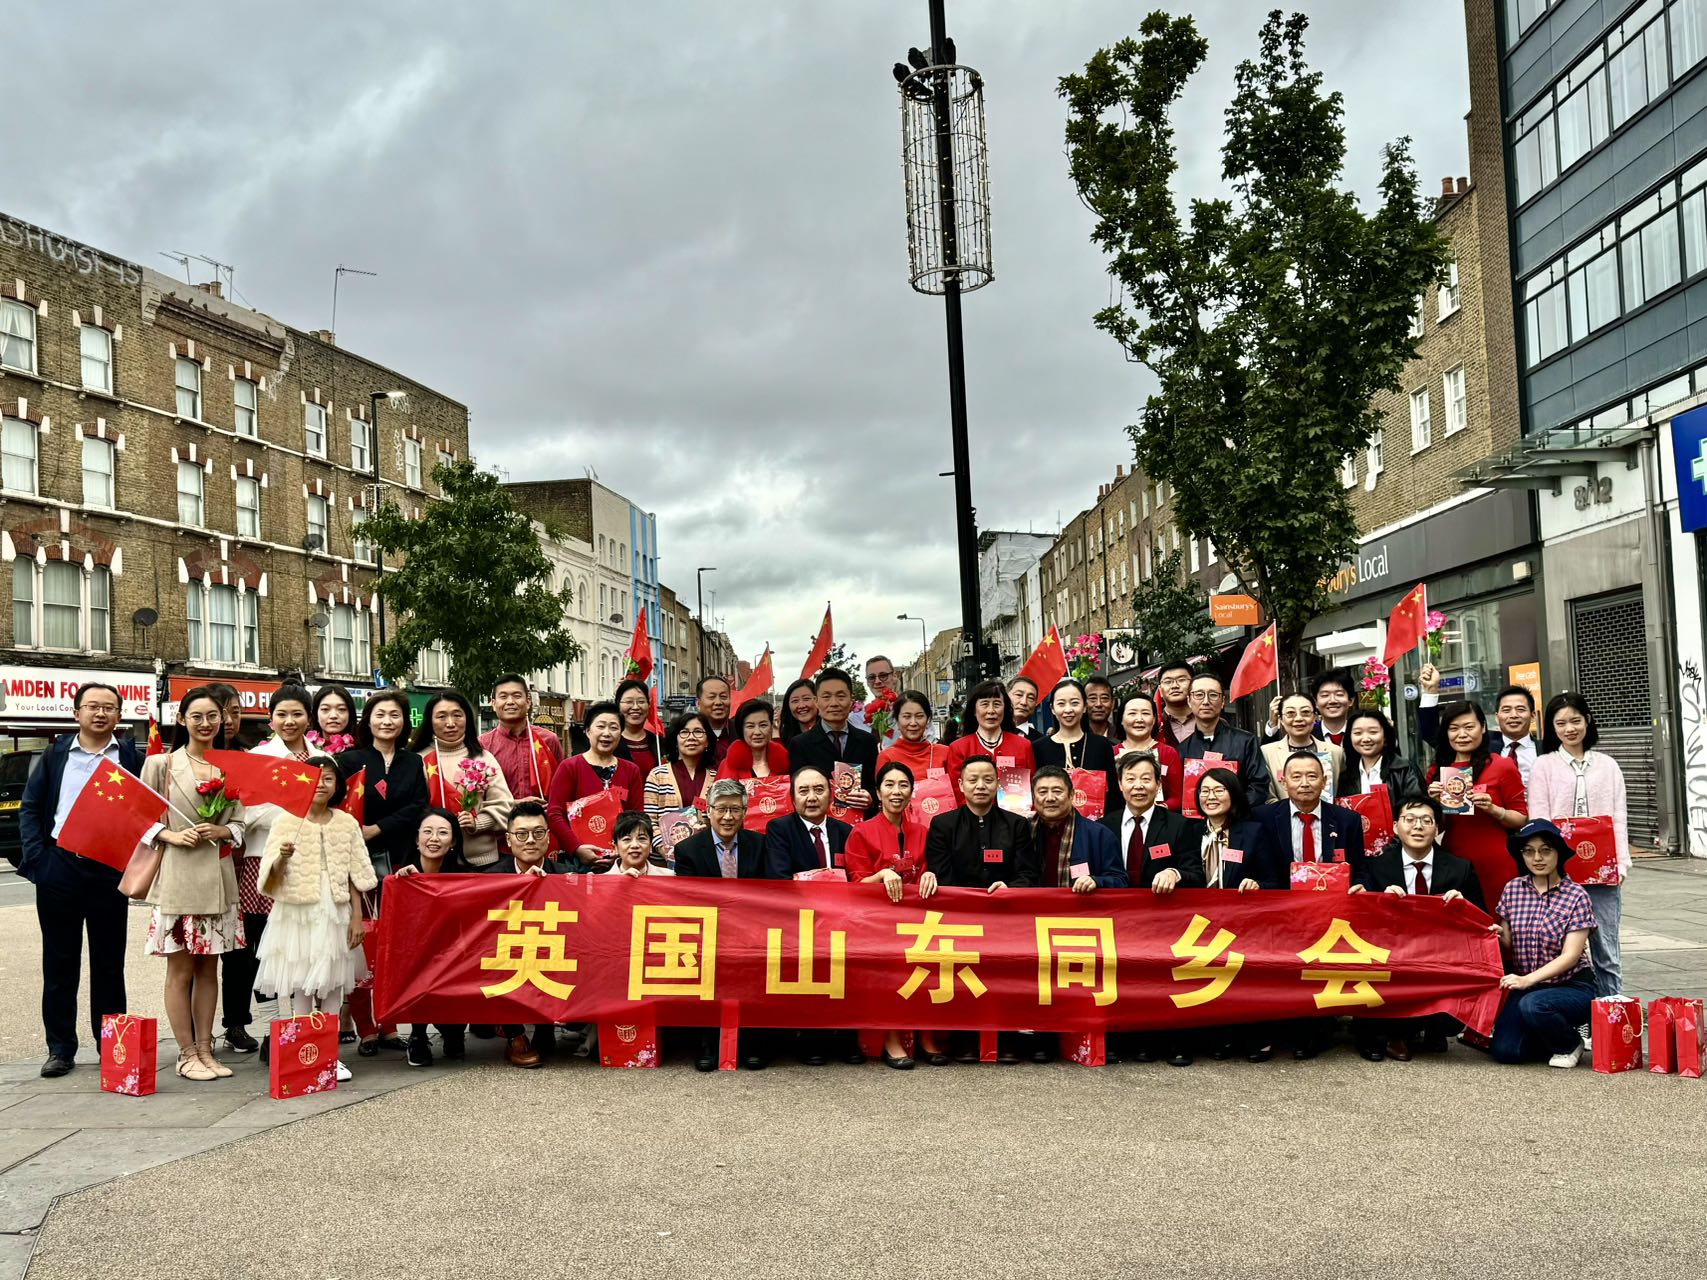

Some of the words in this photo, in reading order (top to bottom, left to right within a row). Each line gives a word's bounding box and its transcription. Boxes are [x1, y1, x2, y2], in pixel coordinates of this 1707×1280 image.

[1358, 544, 1389, 582] Local
[117, 684, 151, 701] WINE
[15, 703, 34, 711] Your
[36, 703, 58, 712] Local
[480, 899, 1392, 1009] 英国山东同乡会
